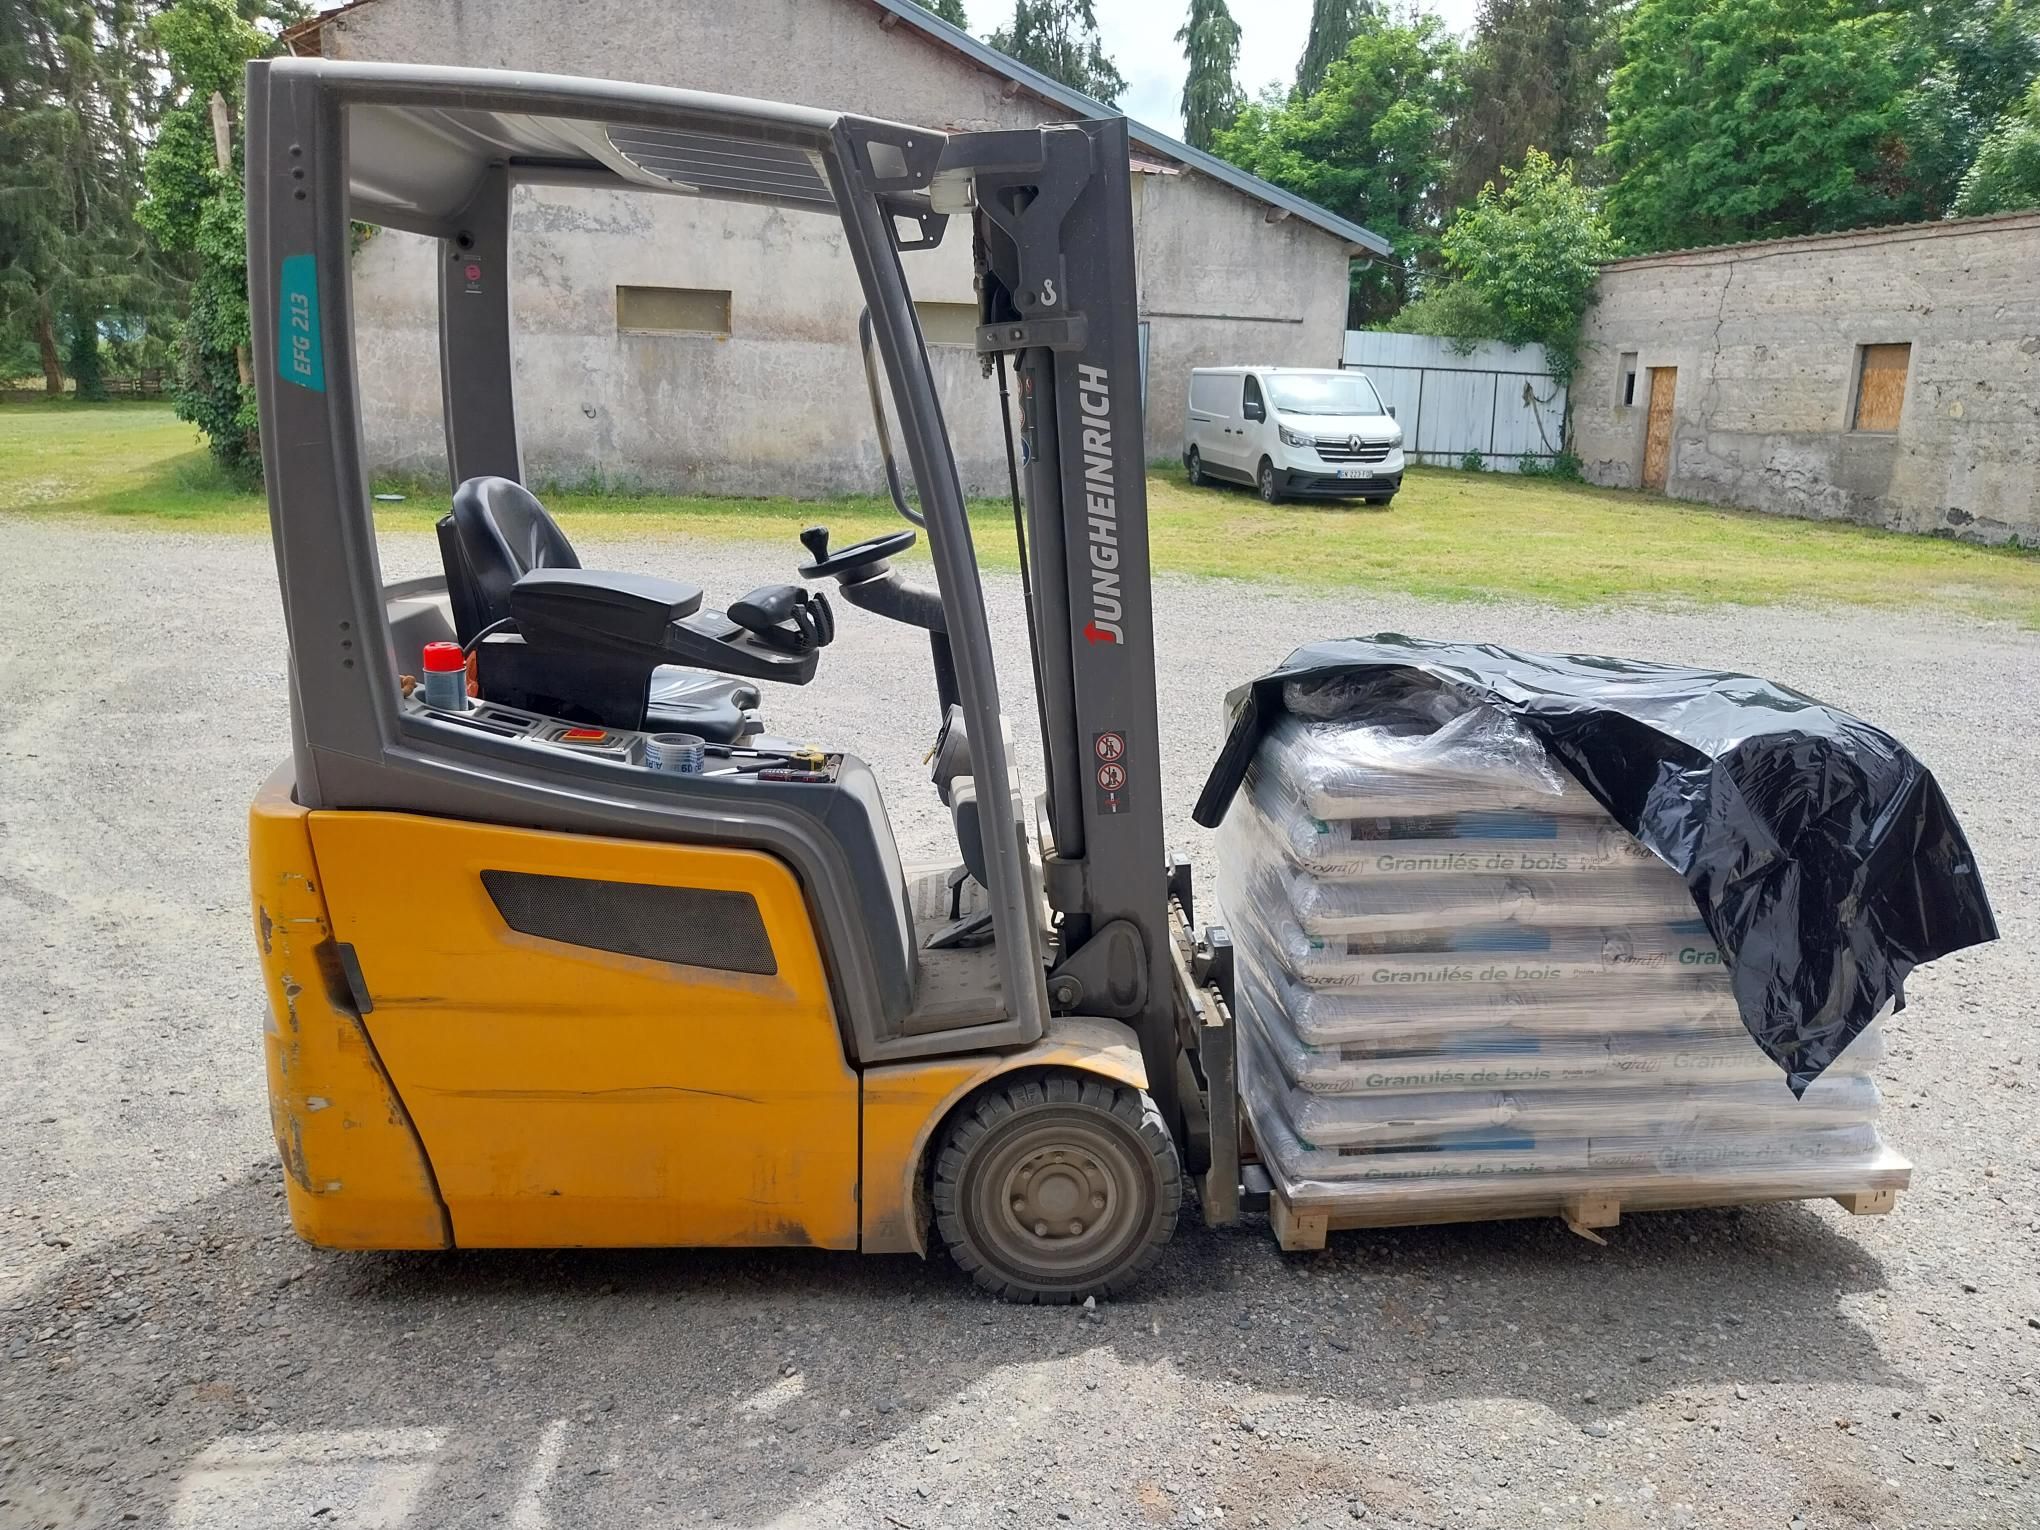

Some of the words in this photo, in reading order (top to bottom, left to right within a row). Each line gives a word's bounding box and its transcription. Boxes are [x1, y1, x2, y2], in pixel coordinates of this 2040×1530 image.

[291, 292, 310, 332] 213
[293, 335, 312, 376] EFG
[1078, 363, 1125, 645] JUNGHEINRICH
[1376, 853, 1479, 872] Granulés
[1486, 854, 1516, 870] de
[1521, 853, 1568, 870] bois
[1372, 966, 1473, 984] Granulés
[1479, 966, 1509, 981] de
[1514, 965, 1561, 981] bois
[1366, 1069, 1465, 1088] Granulés
[1471, 1068, 1499, 1082] de
[1504, 1066, 1551, 1082] bois
